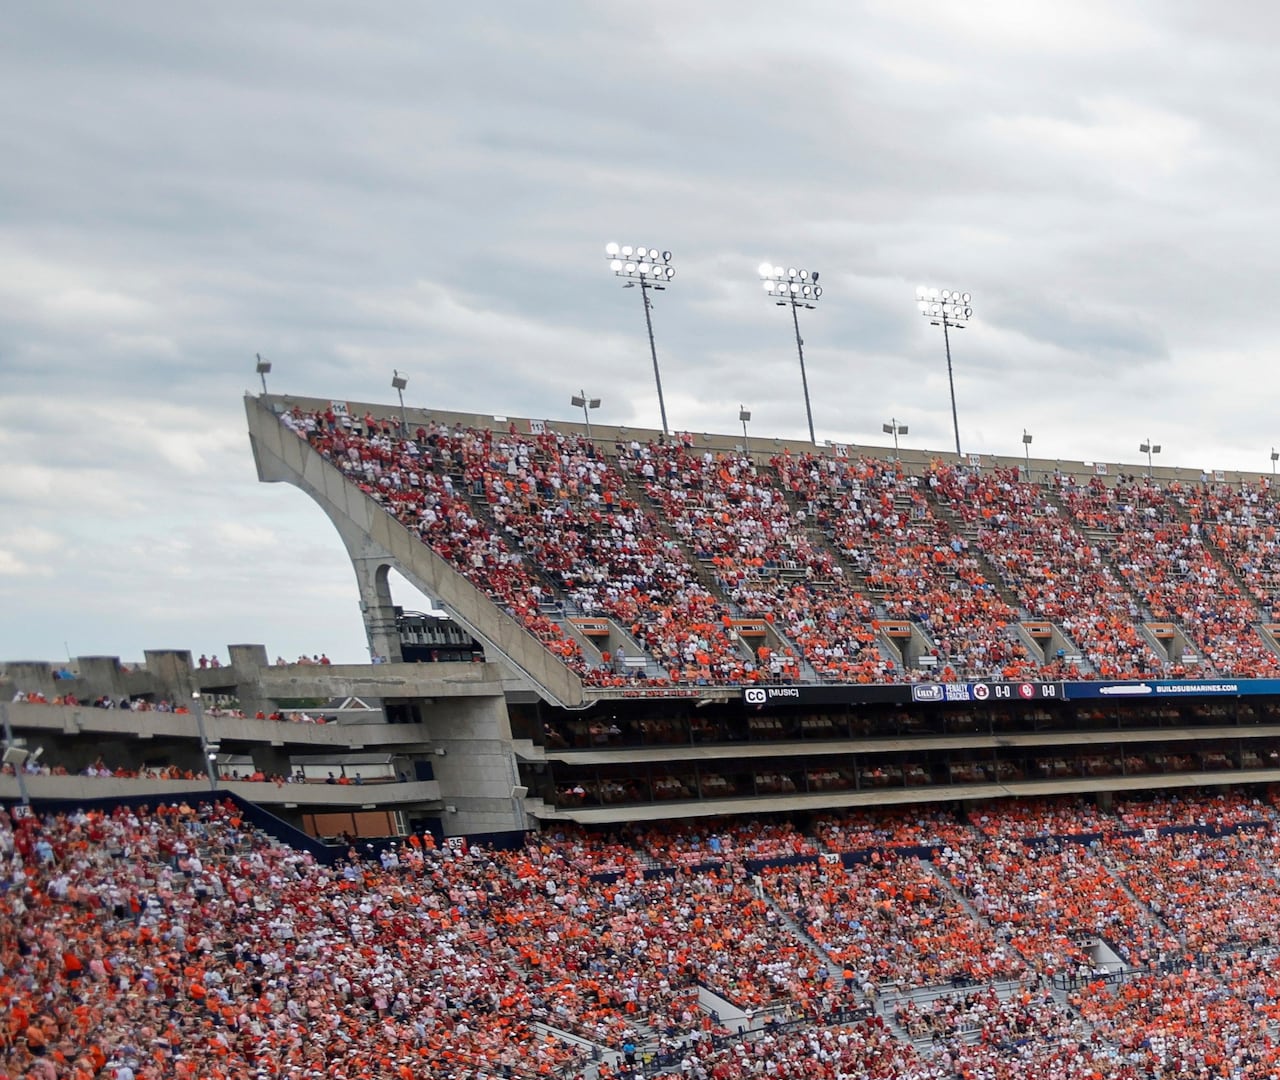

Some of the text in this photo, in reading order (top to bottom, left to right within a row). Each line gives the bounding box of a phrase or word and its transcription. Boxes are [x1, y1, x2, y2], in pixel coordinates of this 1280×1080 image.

[531, 423, 544, 432] 113
[946, 684, 967, 692] PENALTY
[1157, 684, 1237, 692] BUILDSUBMARINES.COM
[747, 689, 799, 701] CC [MUSIC]
[946, 692, 969, 700] TRACKER
[449, 839, 462, 848] 35
